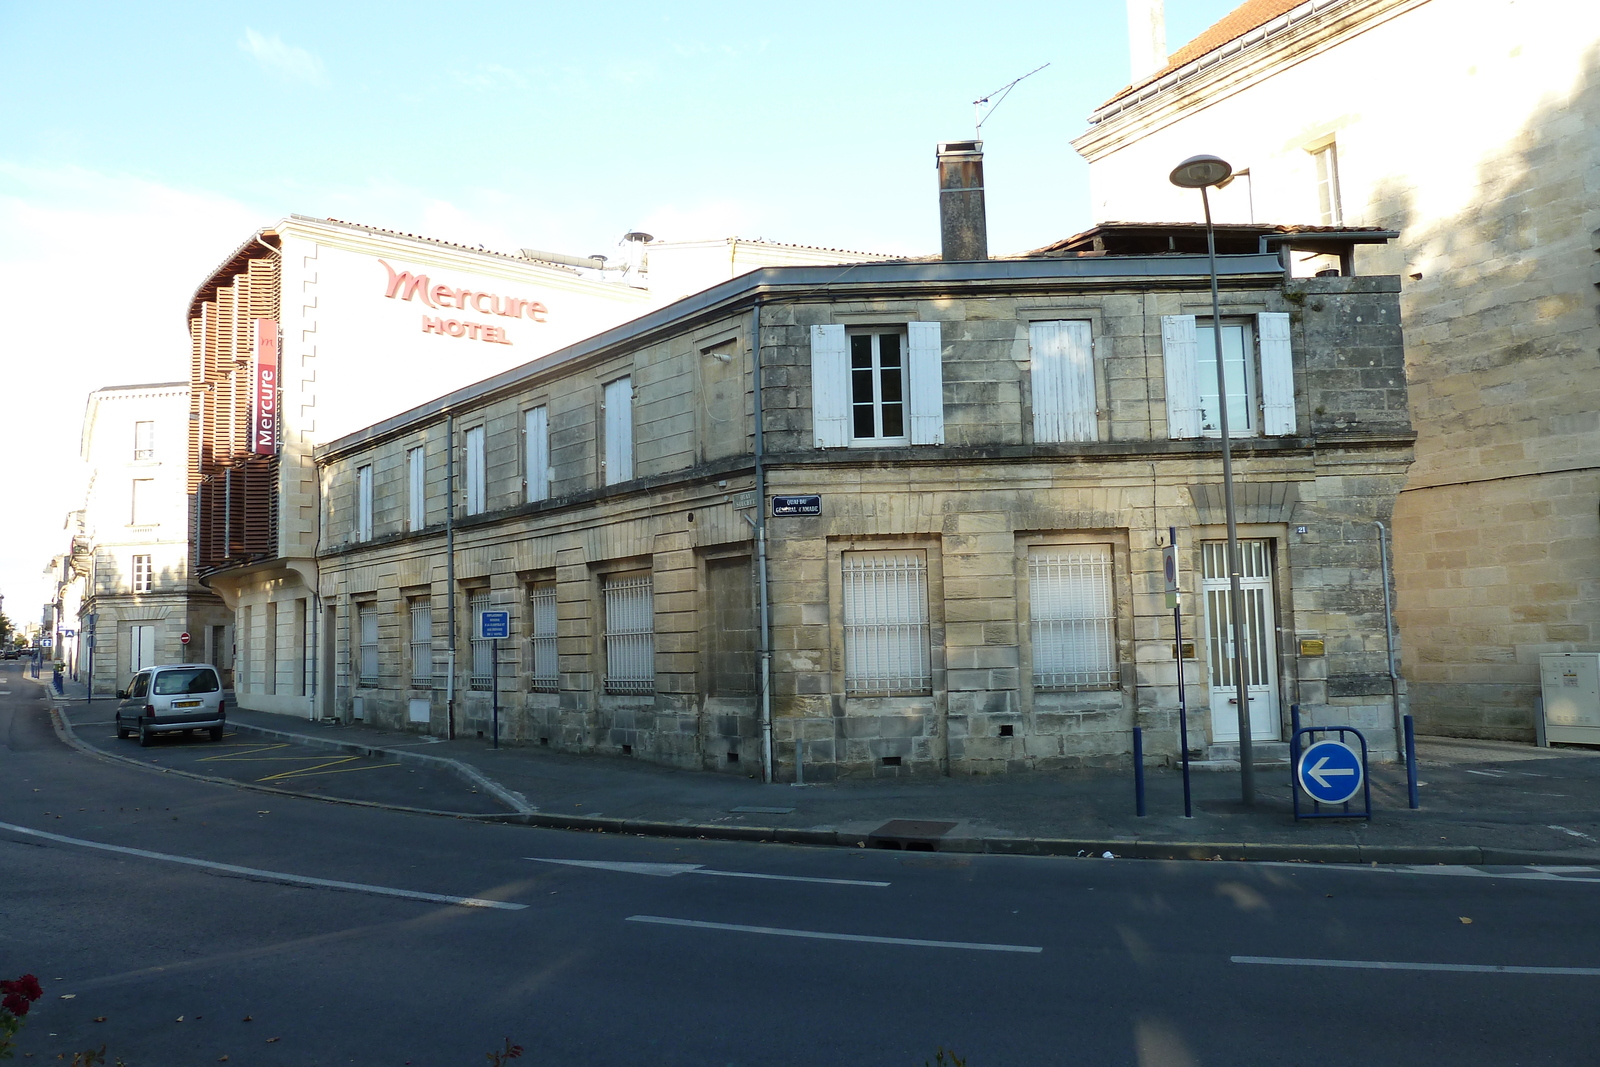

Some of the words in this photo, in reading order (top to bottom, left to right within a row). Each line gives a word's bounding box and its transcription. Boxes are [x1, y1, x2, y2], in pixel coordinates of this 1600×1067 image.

[377, 258, 548, 323] Mercure
[421, 314, 513, 346] HOTEL
[259, 370, 273, 446] Mercure
